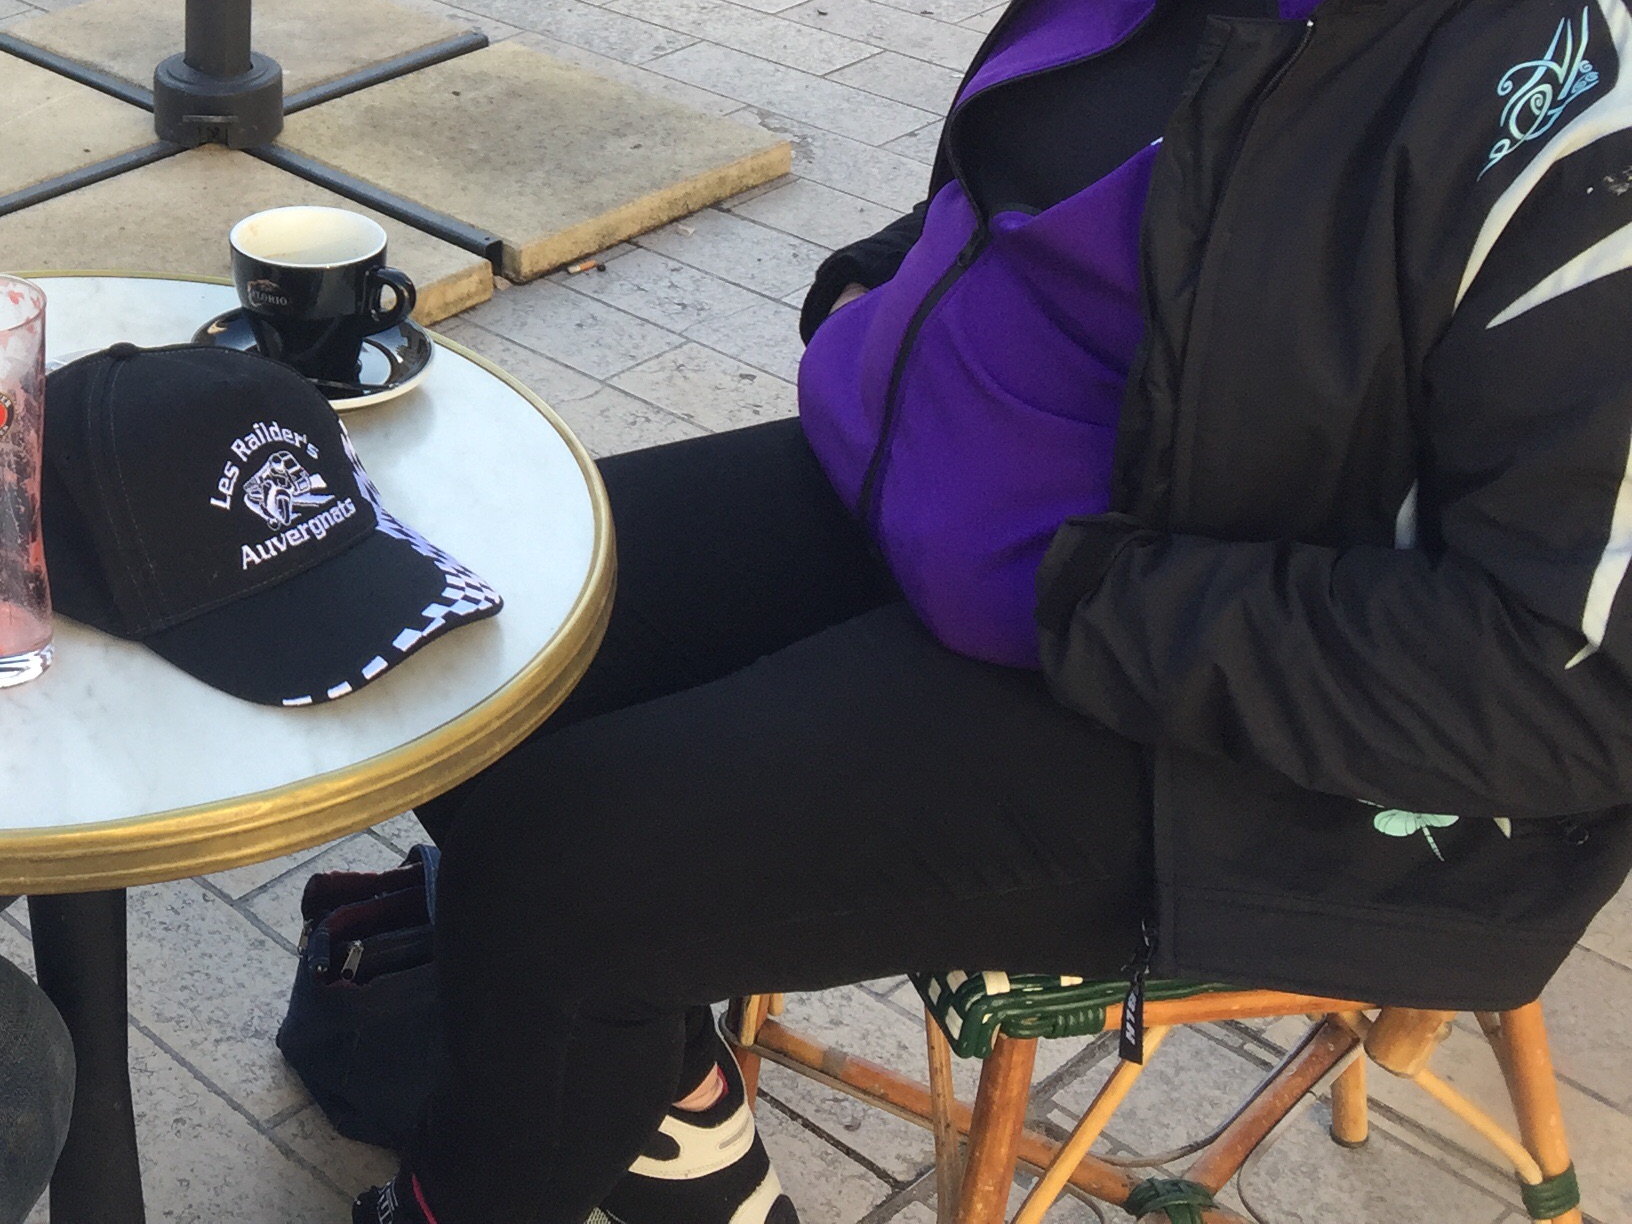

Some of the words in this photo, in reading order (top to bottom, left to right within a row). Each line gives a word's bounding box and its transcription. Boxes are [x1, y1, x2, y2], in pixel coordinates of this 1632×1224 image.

[210, 460, 240, 511] Les
[230, 420, 319, 462] Railder's
[240, 497, 357, 571] Auvergnats
